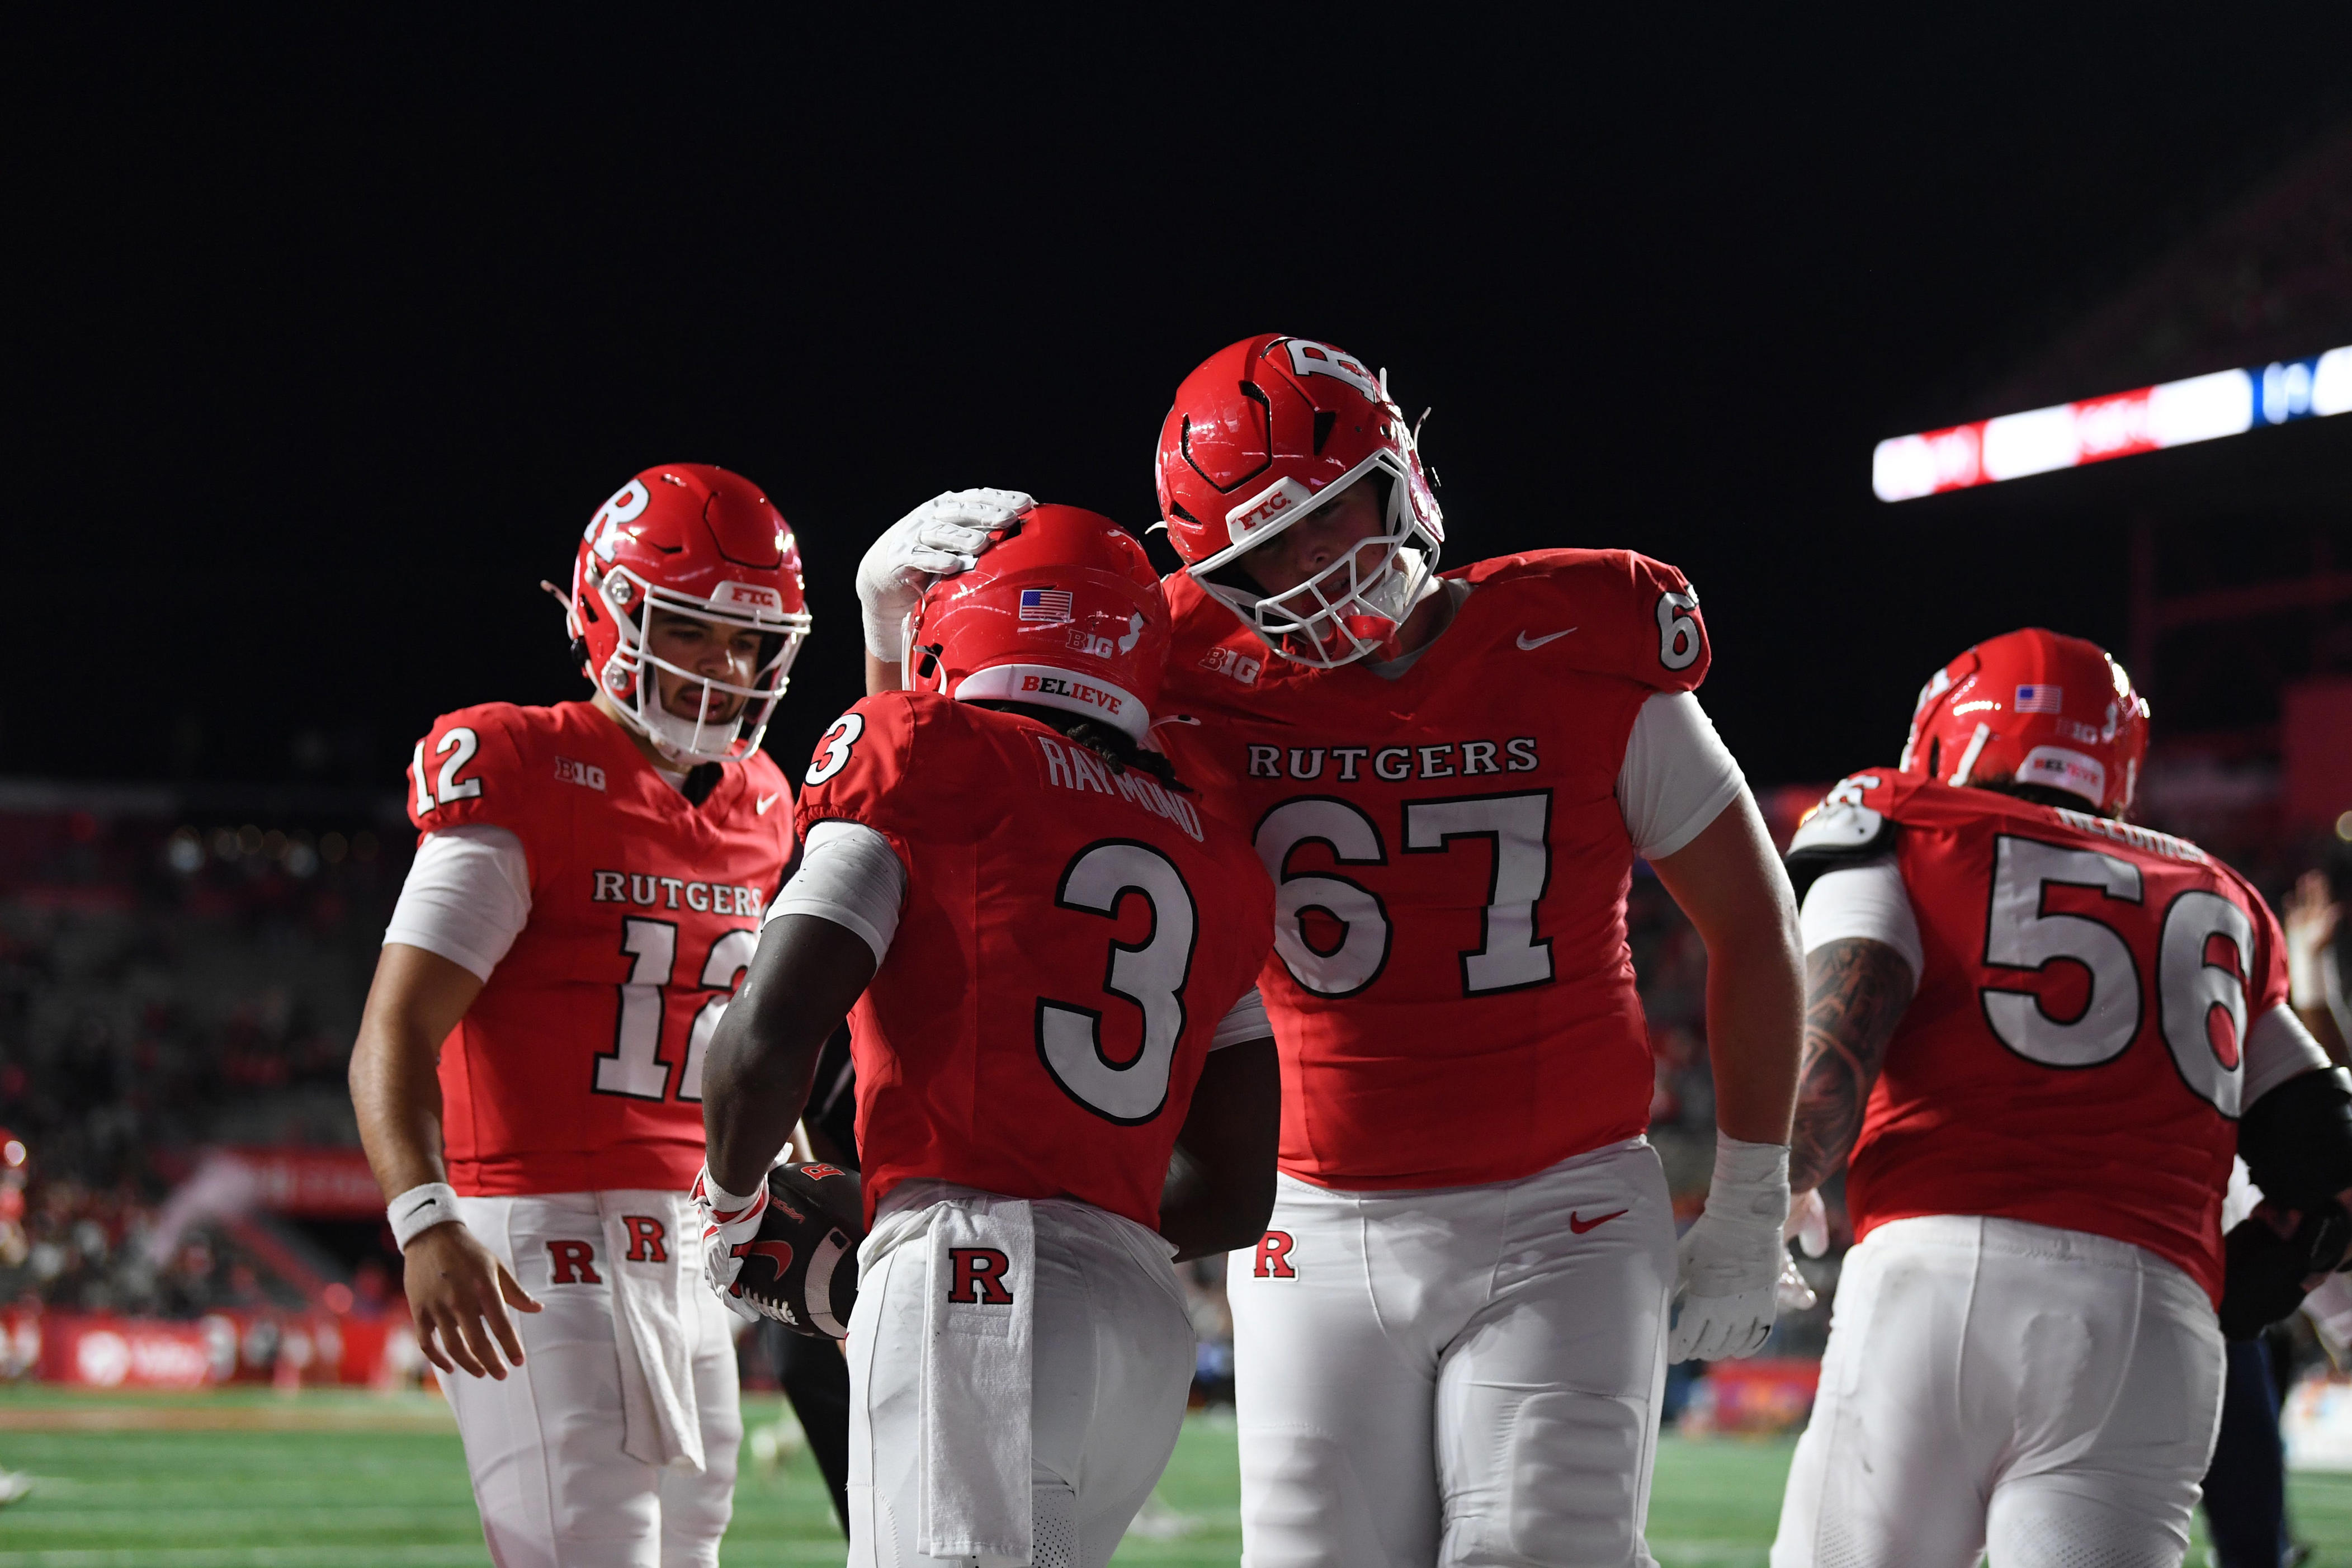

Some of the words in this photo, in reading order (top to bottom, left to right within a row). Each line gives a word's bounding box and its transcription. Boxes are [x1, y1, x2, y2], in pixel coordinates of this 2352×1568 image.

[1284, 338, 1377, 404] R
[584, 479, 650, 563] R
[1655, 582, 1701, 672] 6
[1021, 676, 1122, 716] BELIEVE
[409, 726, 483, 819] 12
[804, 712, 866, 787] 3
[1248, 736, 1541, 781] RUTGERS
[1038, 735, 1205, 842] RAYMOND
[592, 870, 763, 918] RUTGERS
[1251, 788, 1556, 999] 67
[1034, 837, 1199, 1127] 3
[1981, 832, 2254, 1118] 56
[800, 1163, 846, 1181] R
[546, 1240, 602, 1285] R
[622, 1215, 669, 1263] R
[1253, 1230, 1296, 1279] R
[947, 1247, 1014, 1305] R
